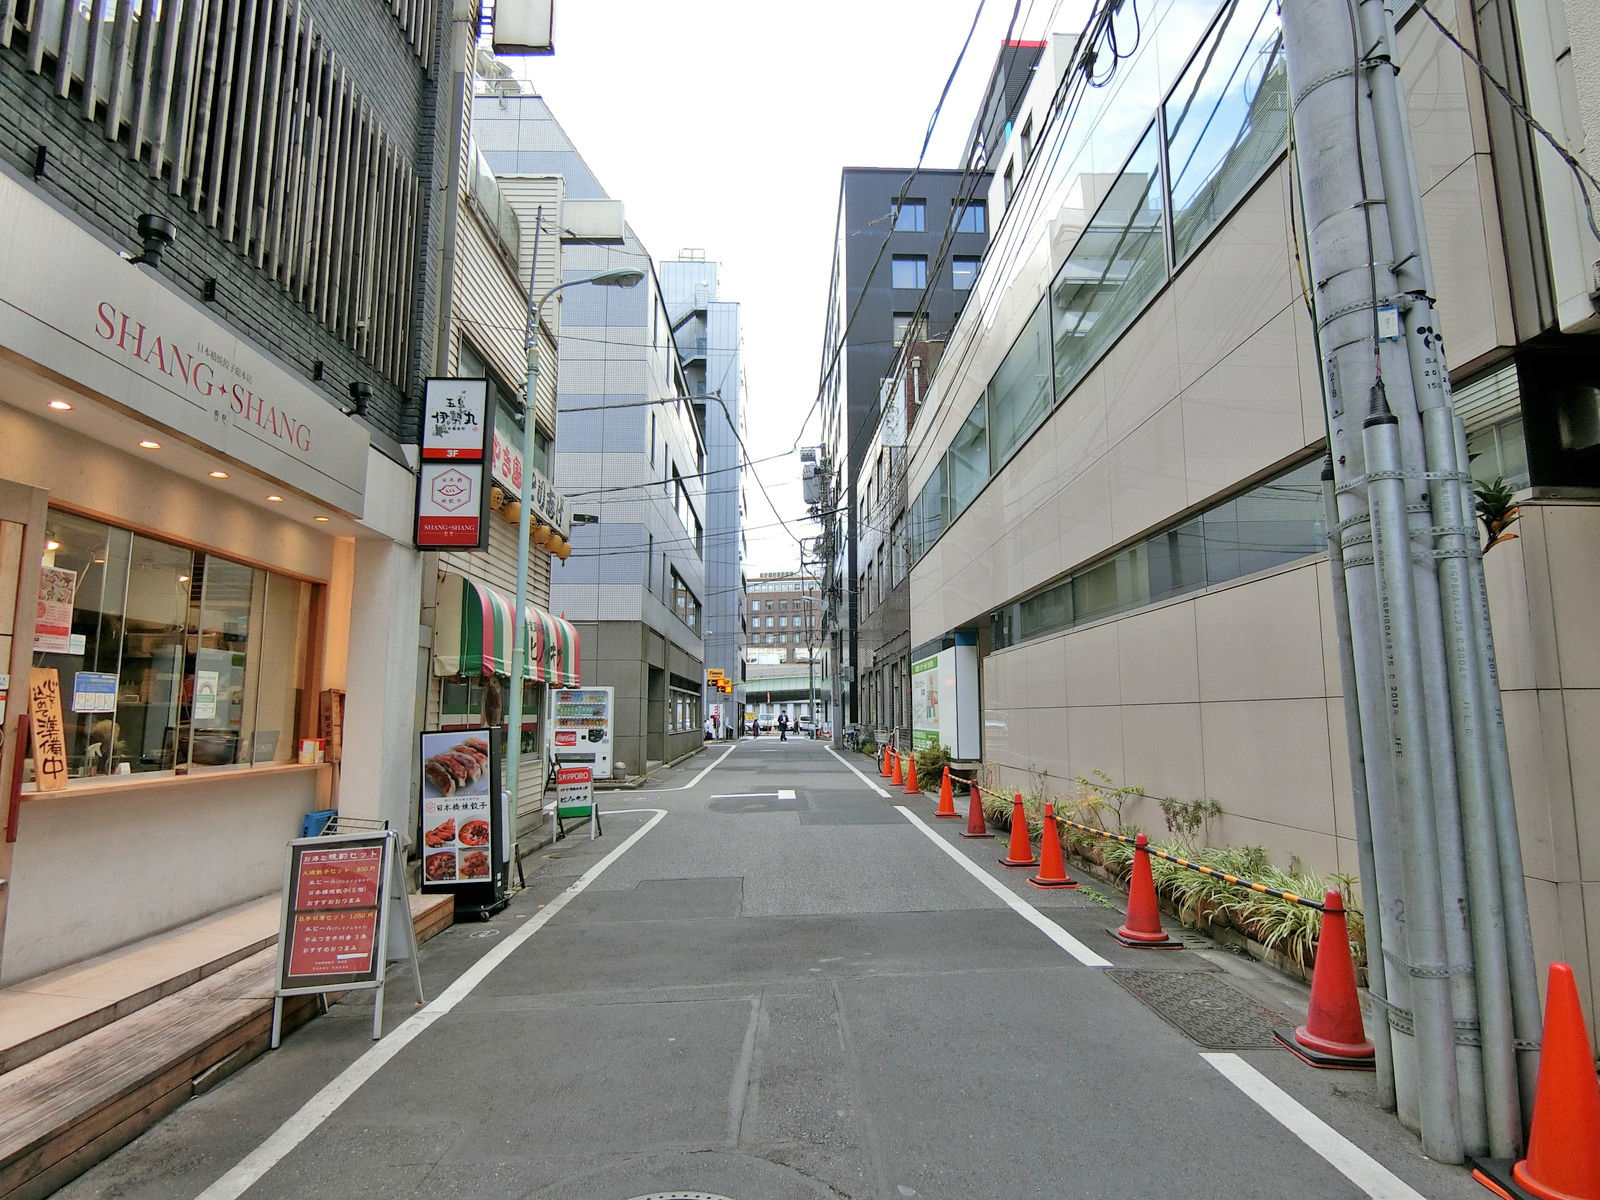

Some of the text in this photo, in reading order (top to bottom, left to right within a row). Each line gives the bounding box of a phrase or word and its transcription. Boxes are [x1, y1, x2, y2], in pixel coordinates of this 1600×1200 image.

[95, 302, 311, 451] SHANG SHANG
[446, 450, 459, 458] 3F
[36, 716, 64, 780] 準備中
[436, 801, 488, 812] 日本橋焼餃子
[304, 850, 378, 863] お得な晩酌セット
